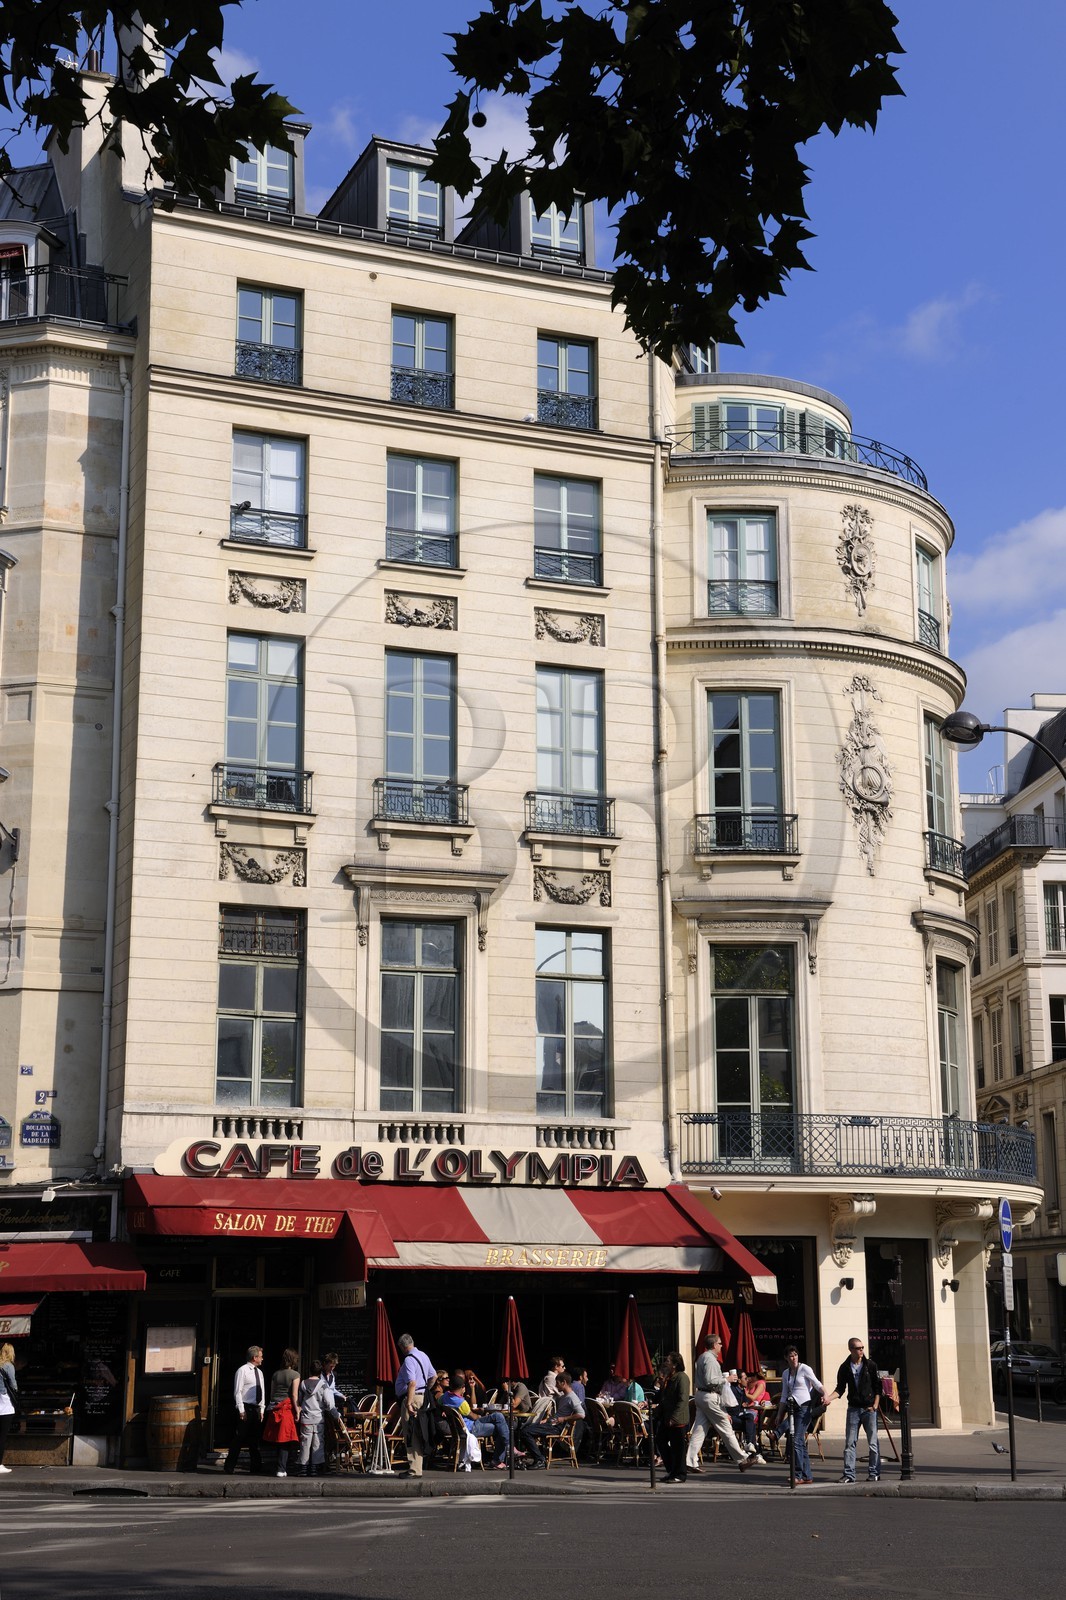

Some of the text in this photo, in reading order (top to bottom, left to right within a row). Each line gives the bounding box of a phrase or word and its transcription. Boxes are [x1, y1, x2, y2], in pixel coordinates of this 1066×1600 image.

[38, 1091, 45, 1103] 2
[184, 1140, 648, 1185] CAFE de L'OLYMPIA
[213, 1212, 336, 1233] SALON DE THE
[484, 1248, 609, 1267] BRASSERIE
[160, 1269, 181, 1278] CAFE
[325, 1287, 360, 1306] BRASSERIE
